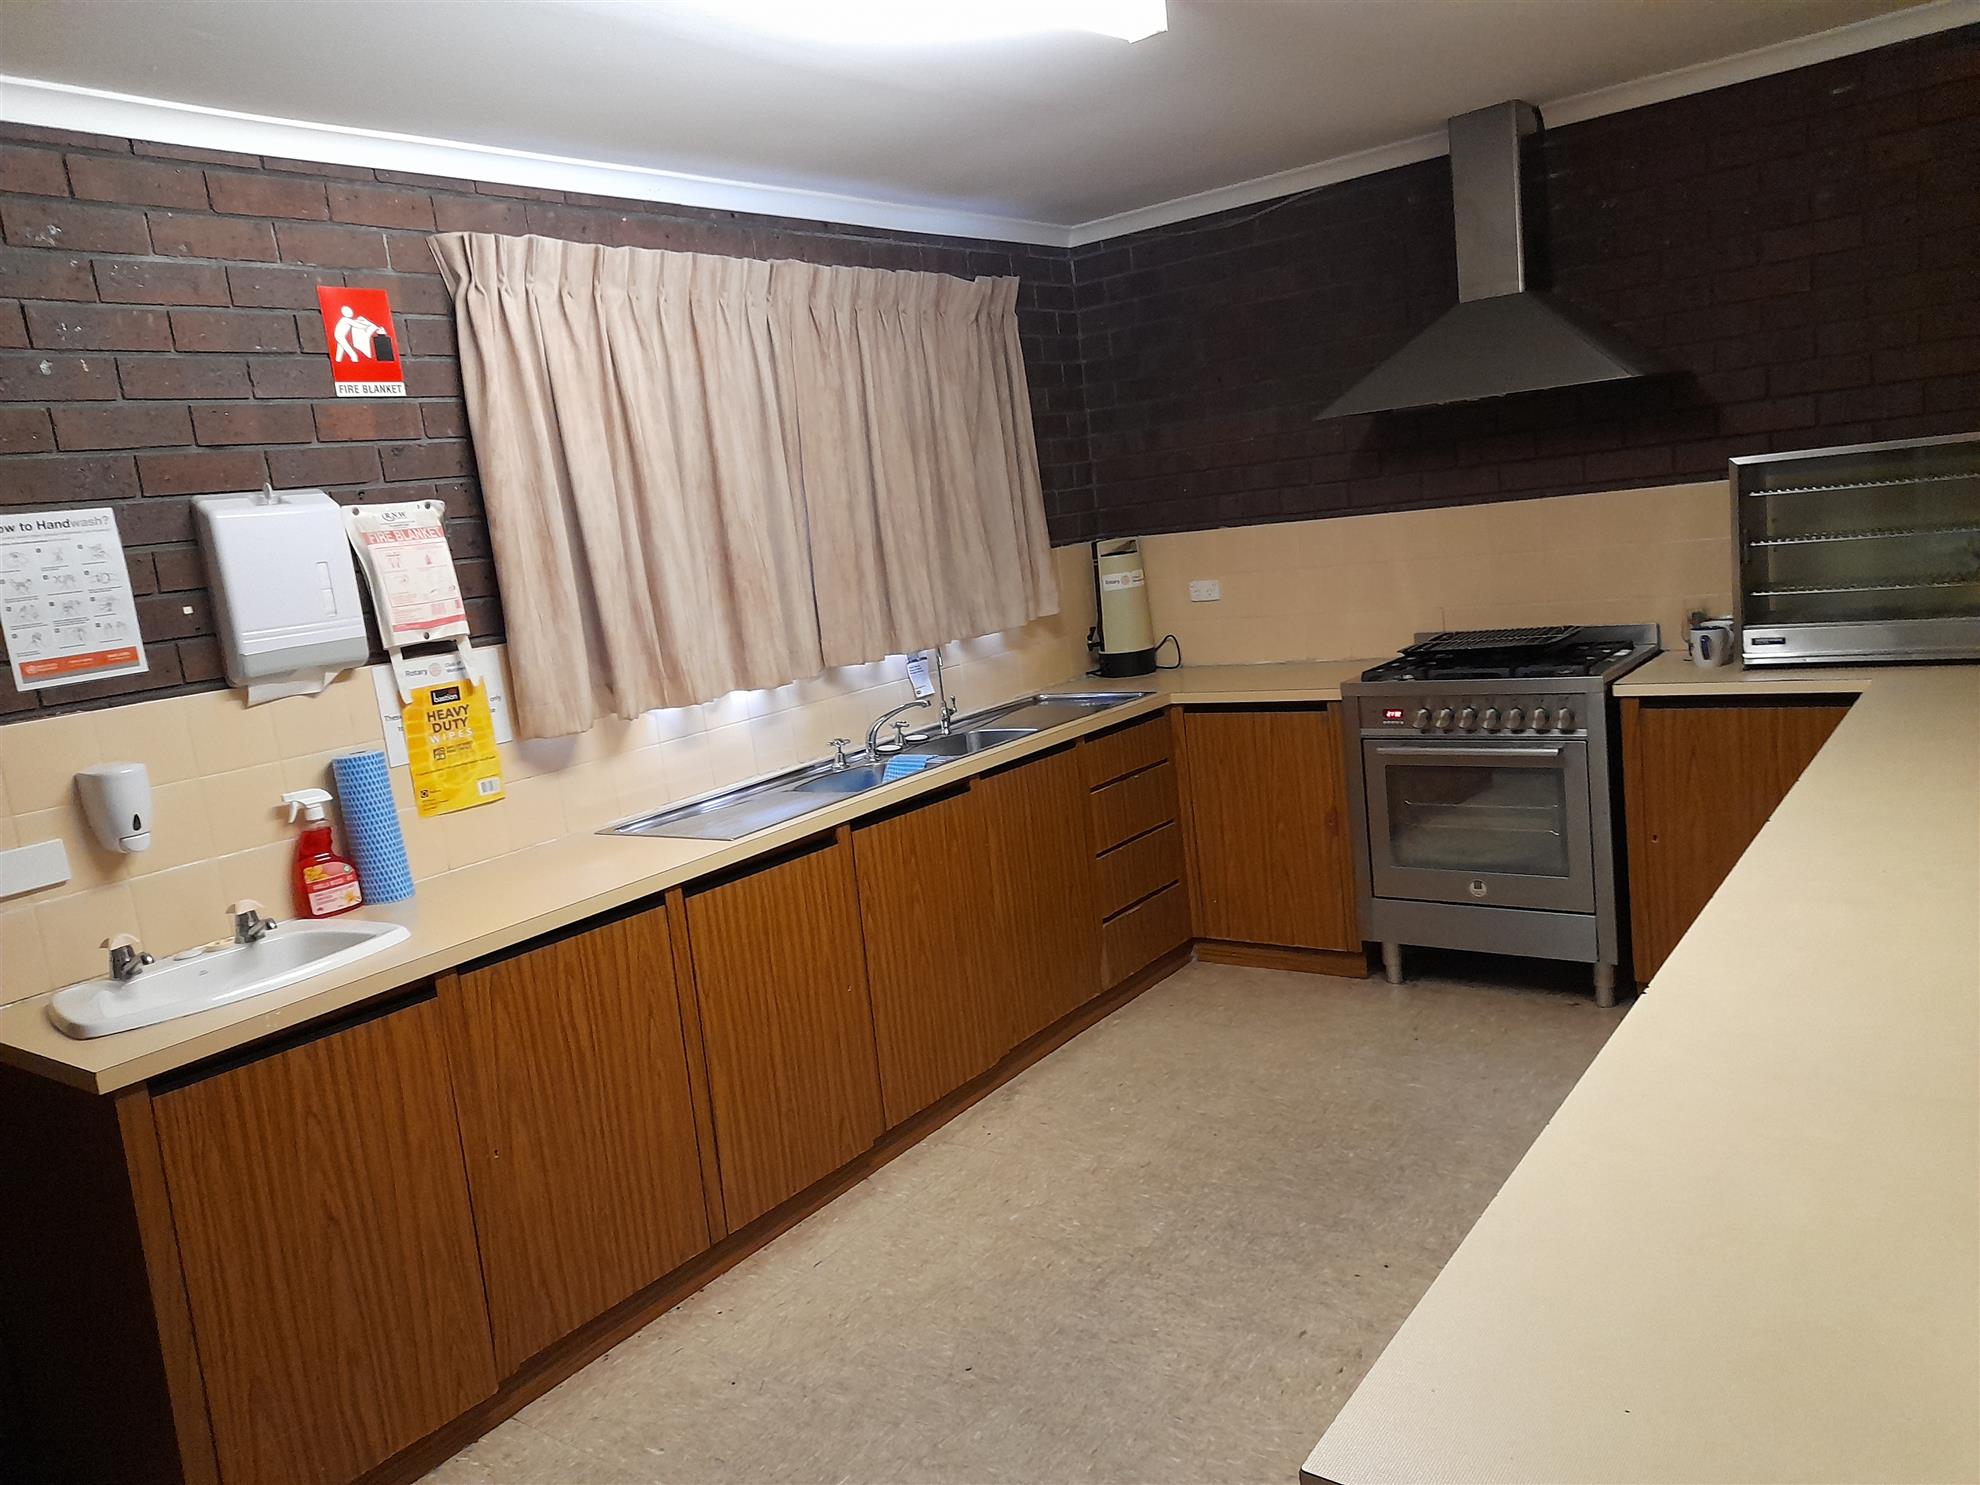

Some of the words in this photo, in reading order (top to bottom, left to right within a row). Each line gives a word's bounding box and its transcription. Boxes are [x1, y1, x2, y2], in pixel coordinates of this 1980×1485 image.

[338, 384, 359, 394] FIRE
[362, 384, 402, 394] BLANKET
[0, 524, 15, 533] ow
[19, 522, 32, 531] to
[36, 515, 109, 530] Handwash?
[368, 531, 395, 544] FIRE
[395, 527, 442, 542] BLANKET
[405, 669, 428, 677] Rotary
[427, 704, 469, 722] HEAVY
[432, 717, 468, 733] DUTY
[431, 729, 473, 744] WIPES
